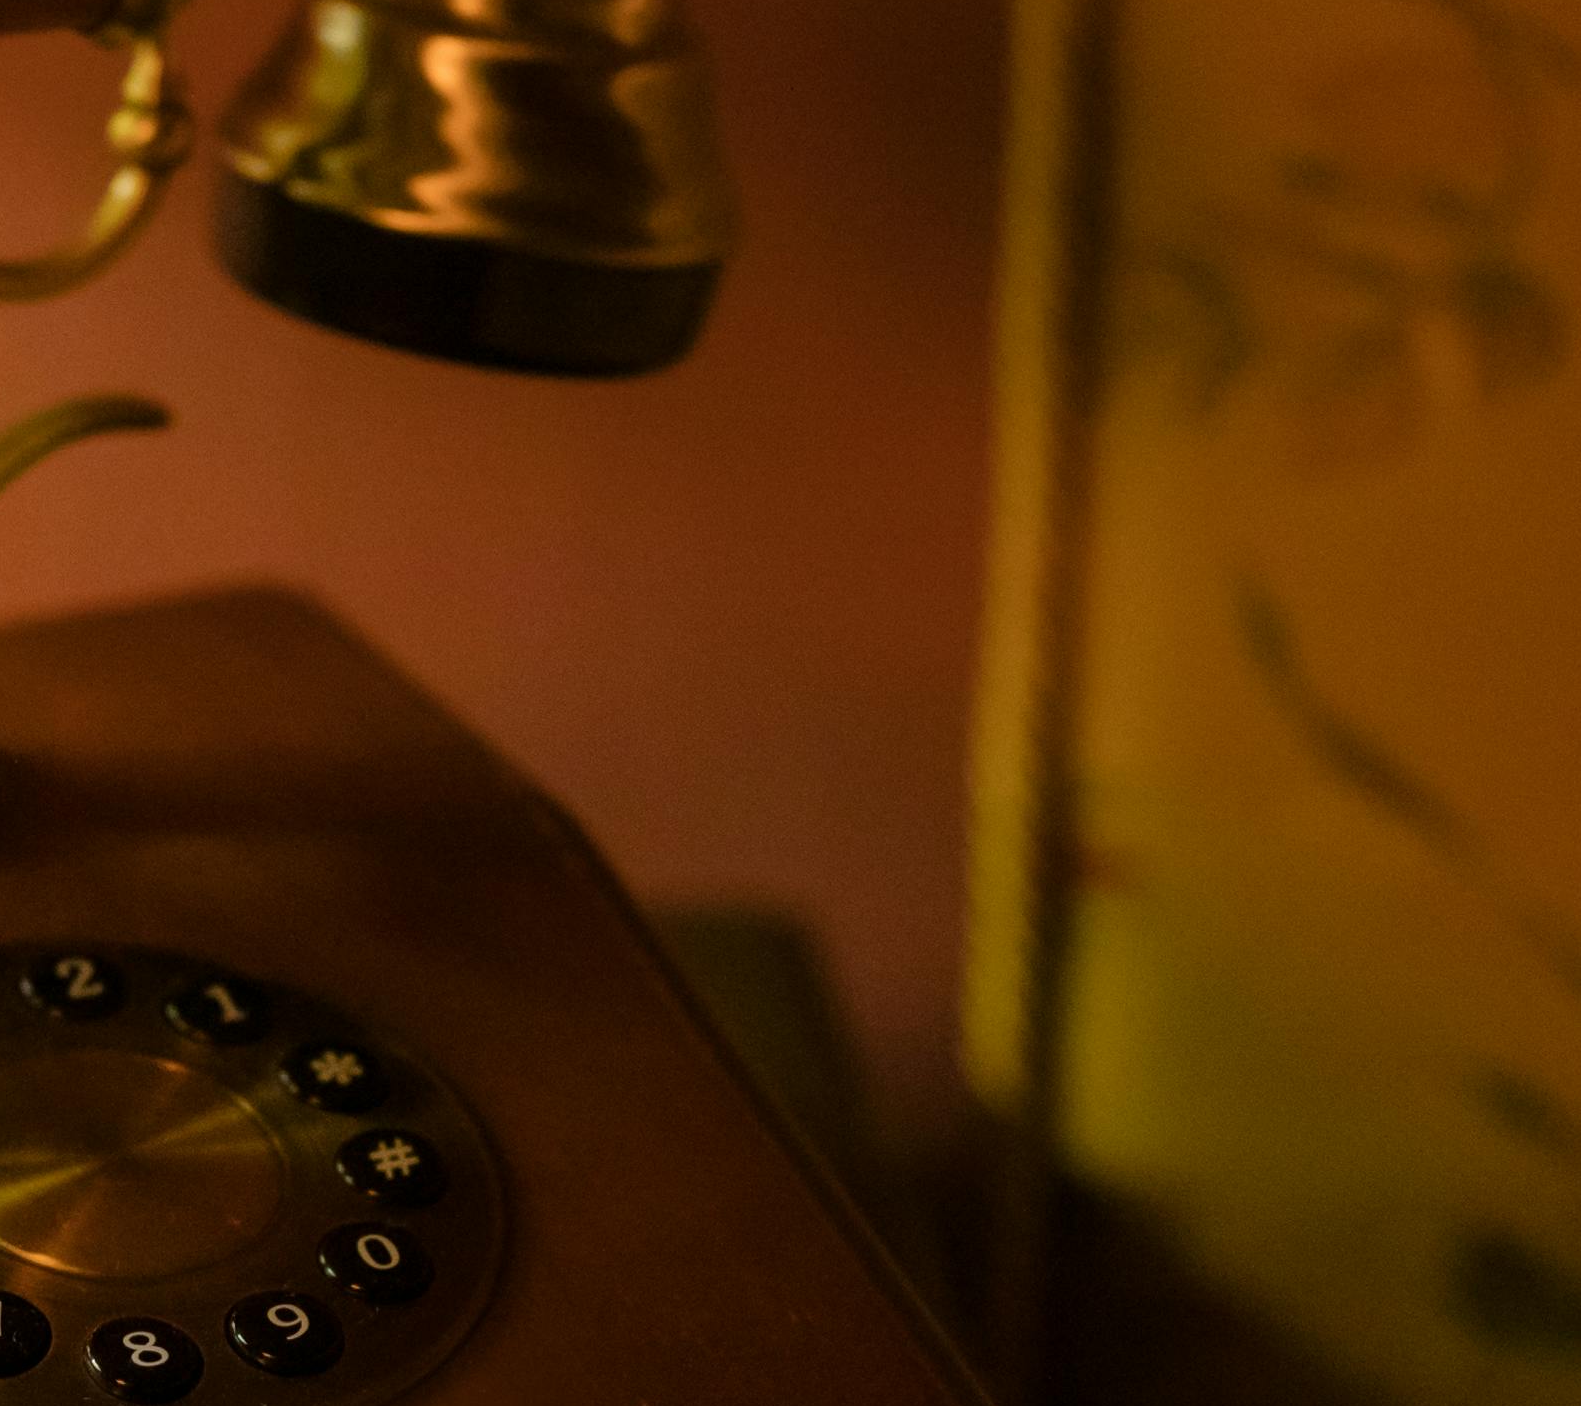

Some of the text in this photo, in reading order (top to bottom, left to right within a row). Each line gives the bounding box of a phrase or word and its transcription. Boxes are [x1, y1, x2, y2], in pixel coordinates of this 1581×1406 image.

[56, 958, 103, 1000] 2
[206, 984, 245, 1023] 1
[356, 1232, 401, 1271] 0
[266, 1303, 311, 1342] 9
[122, 1330, 171, 1369] 8
